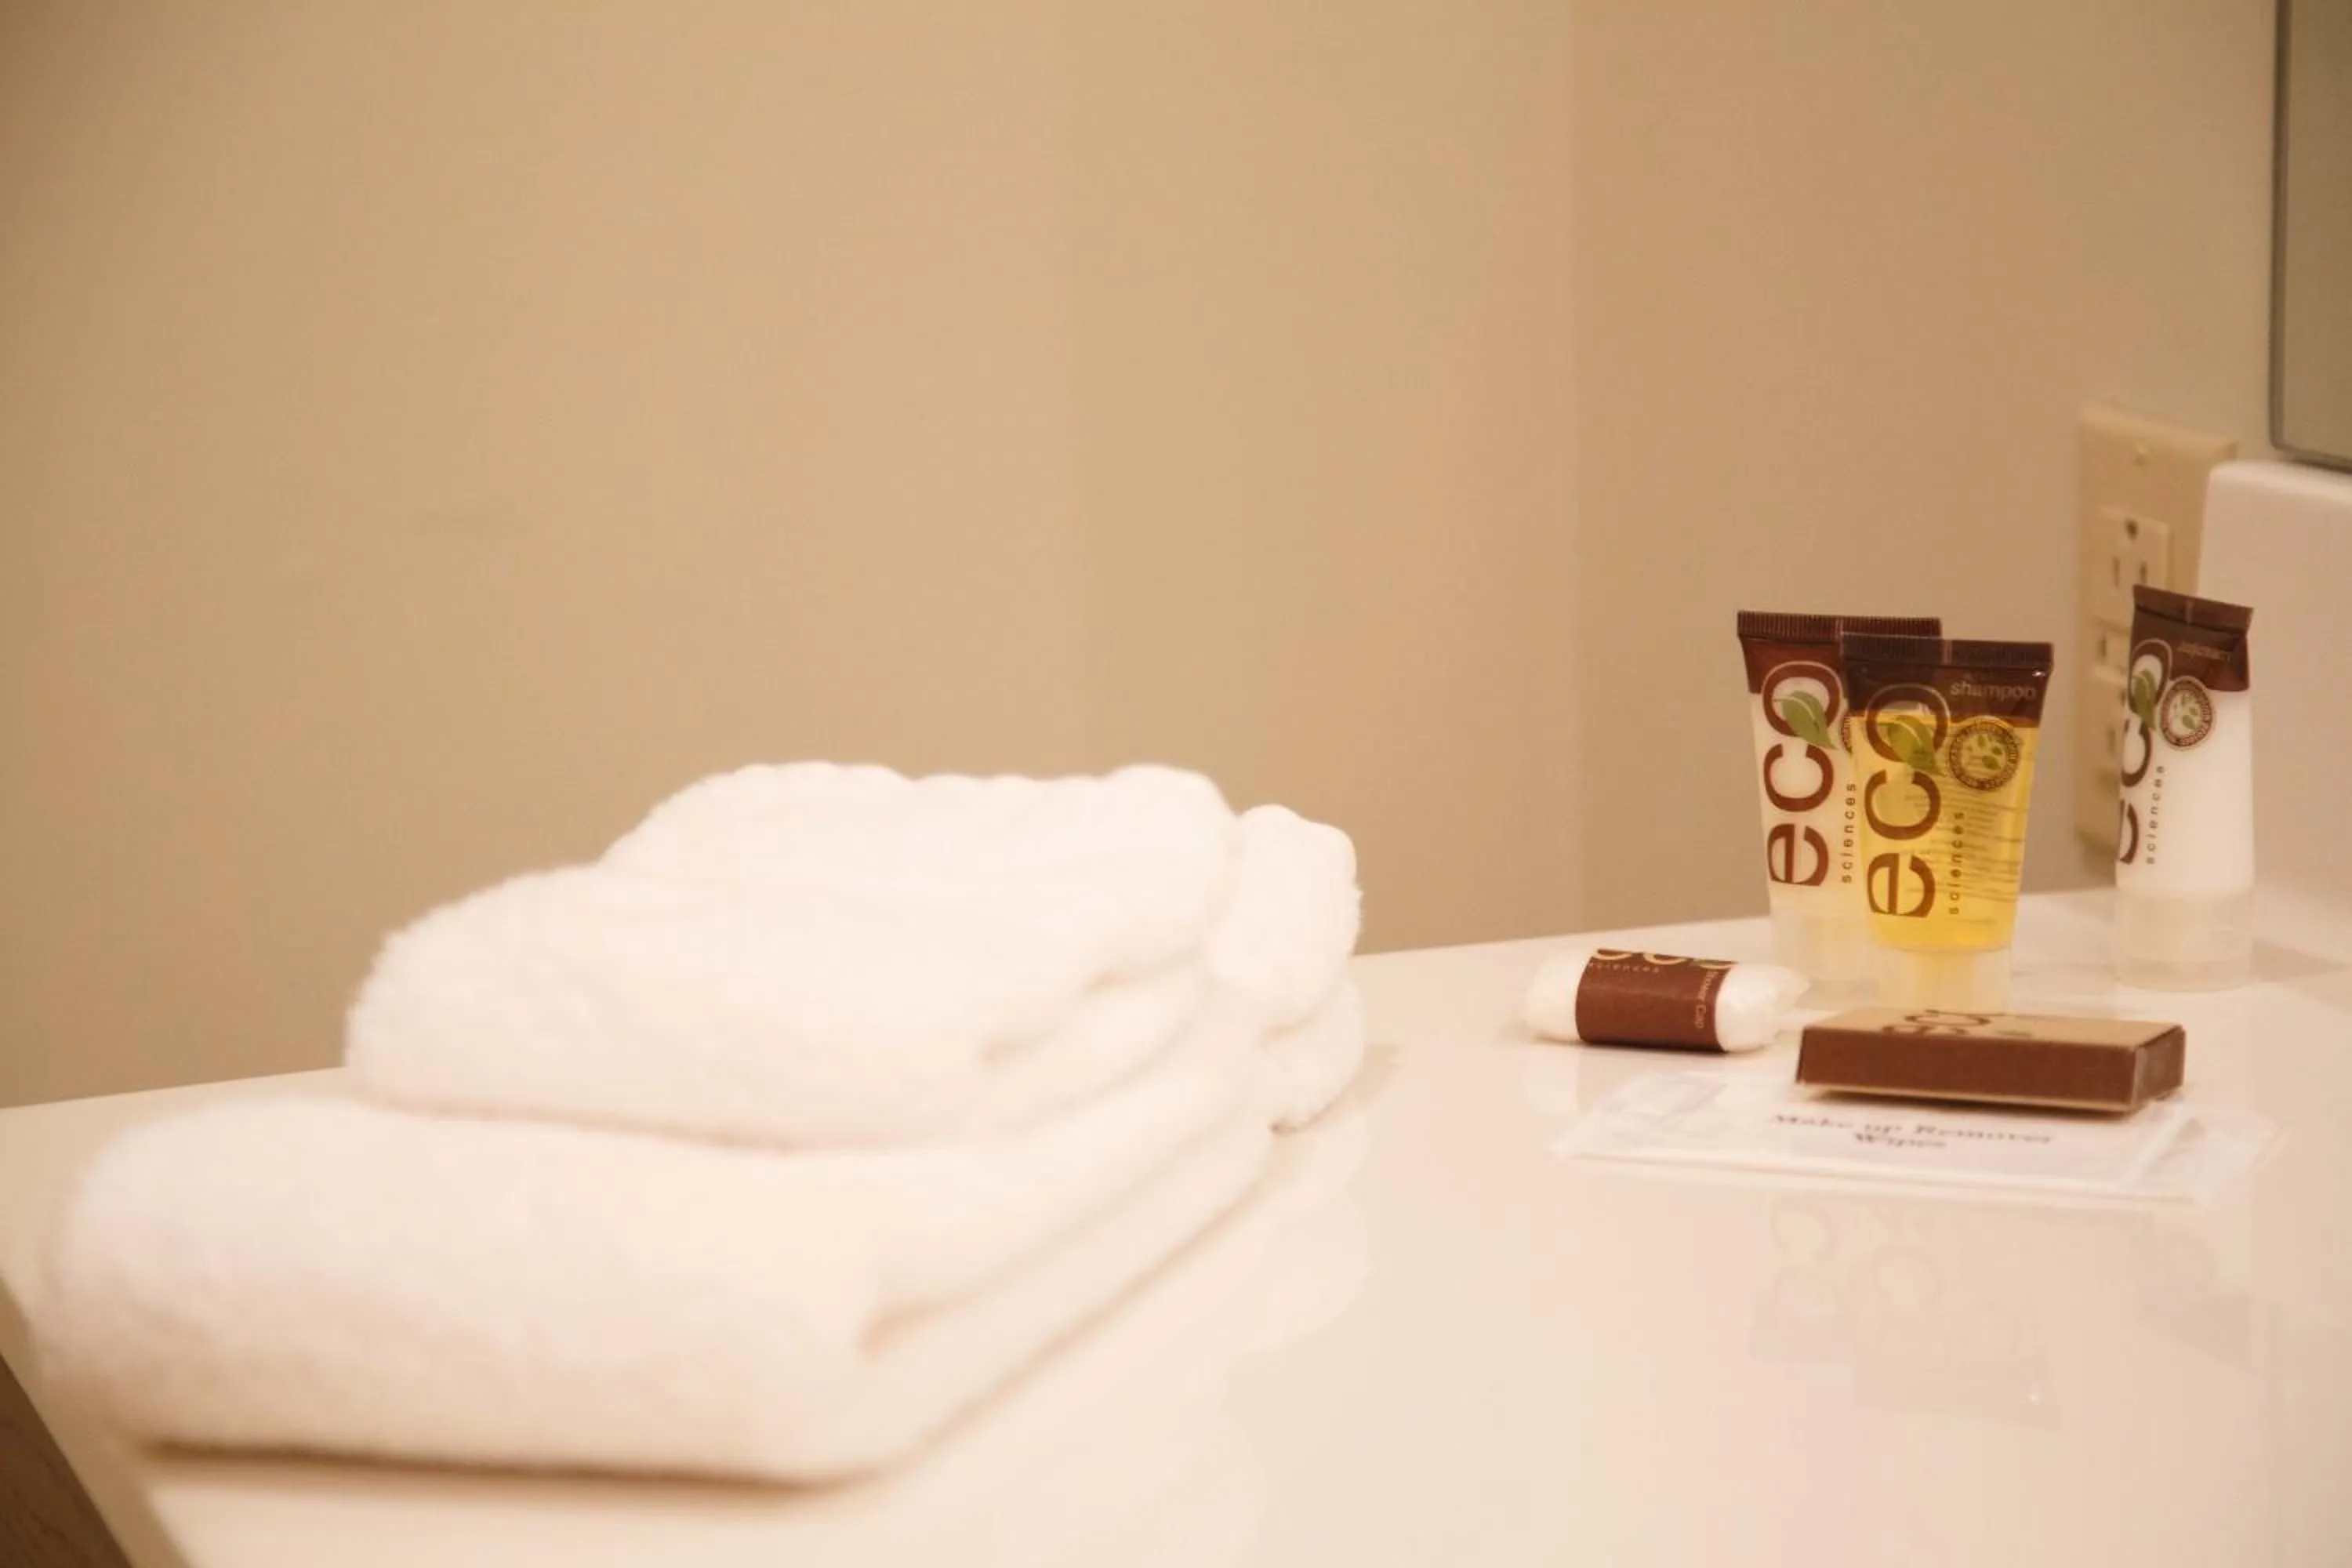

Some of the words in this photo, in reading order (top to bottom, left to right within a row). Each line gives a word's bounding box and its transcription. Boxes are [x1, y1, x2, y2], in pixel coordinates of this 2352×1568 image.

[1950, 680, 2038, 701] shampoo
[1762, 660, 1841, 887] eco
[1864, 683, 1951, 919] eco
[2146, 764, 2165, 866] sciences
[1840, 783, 1857, 884] sciences
[1948, 811, 1965, 916] sciences
